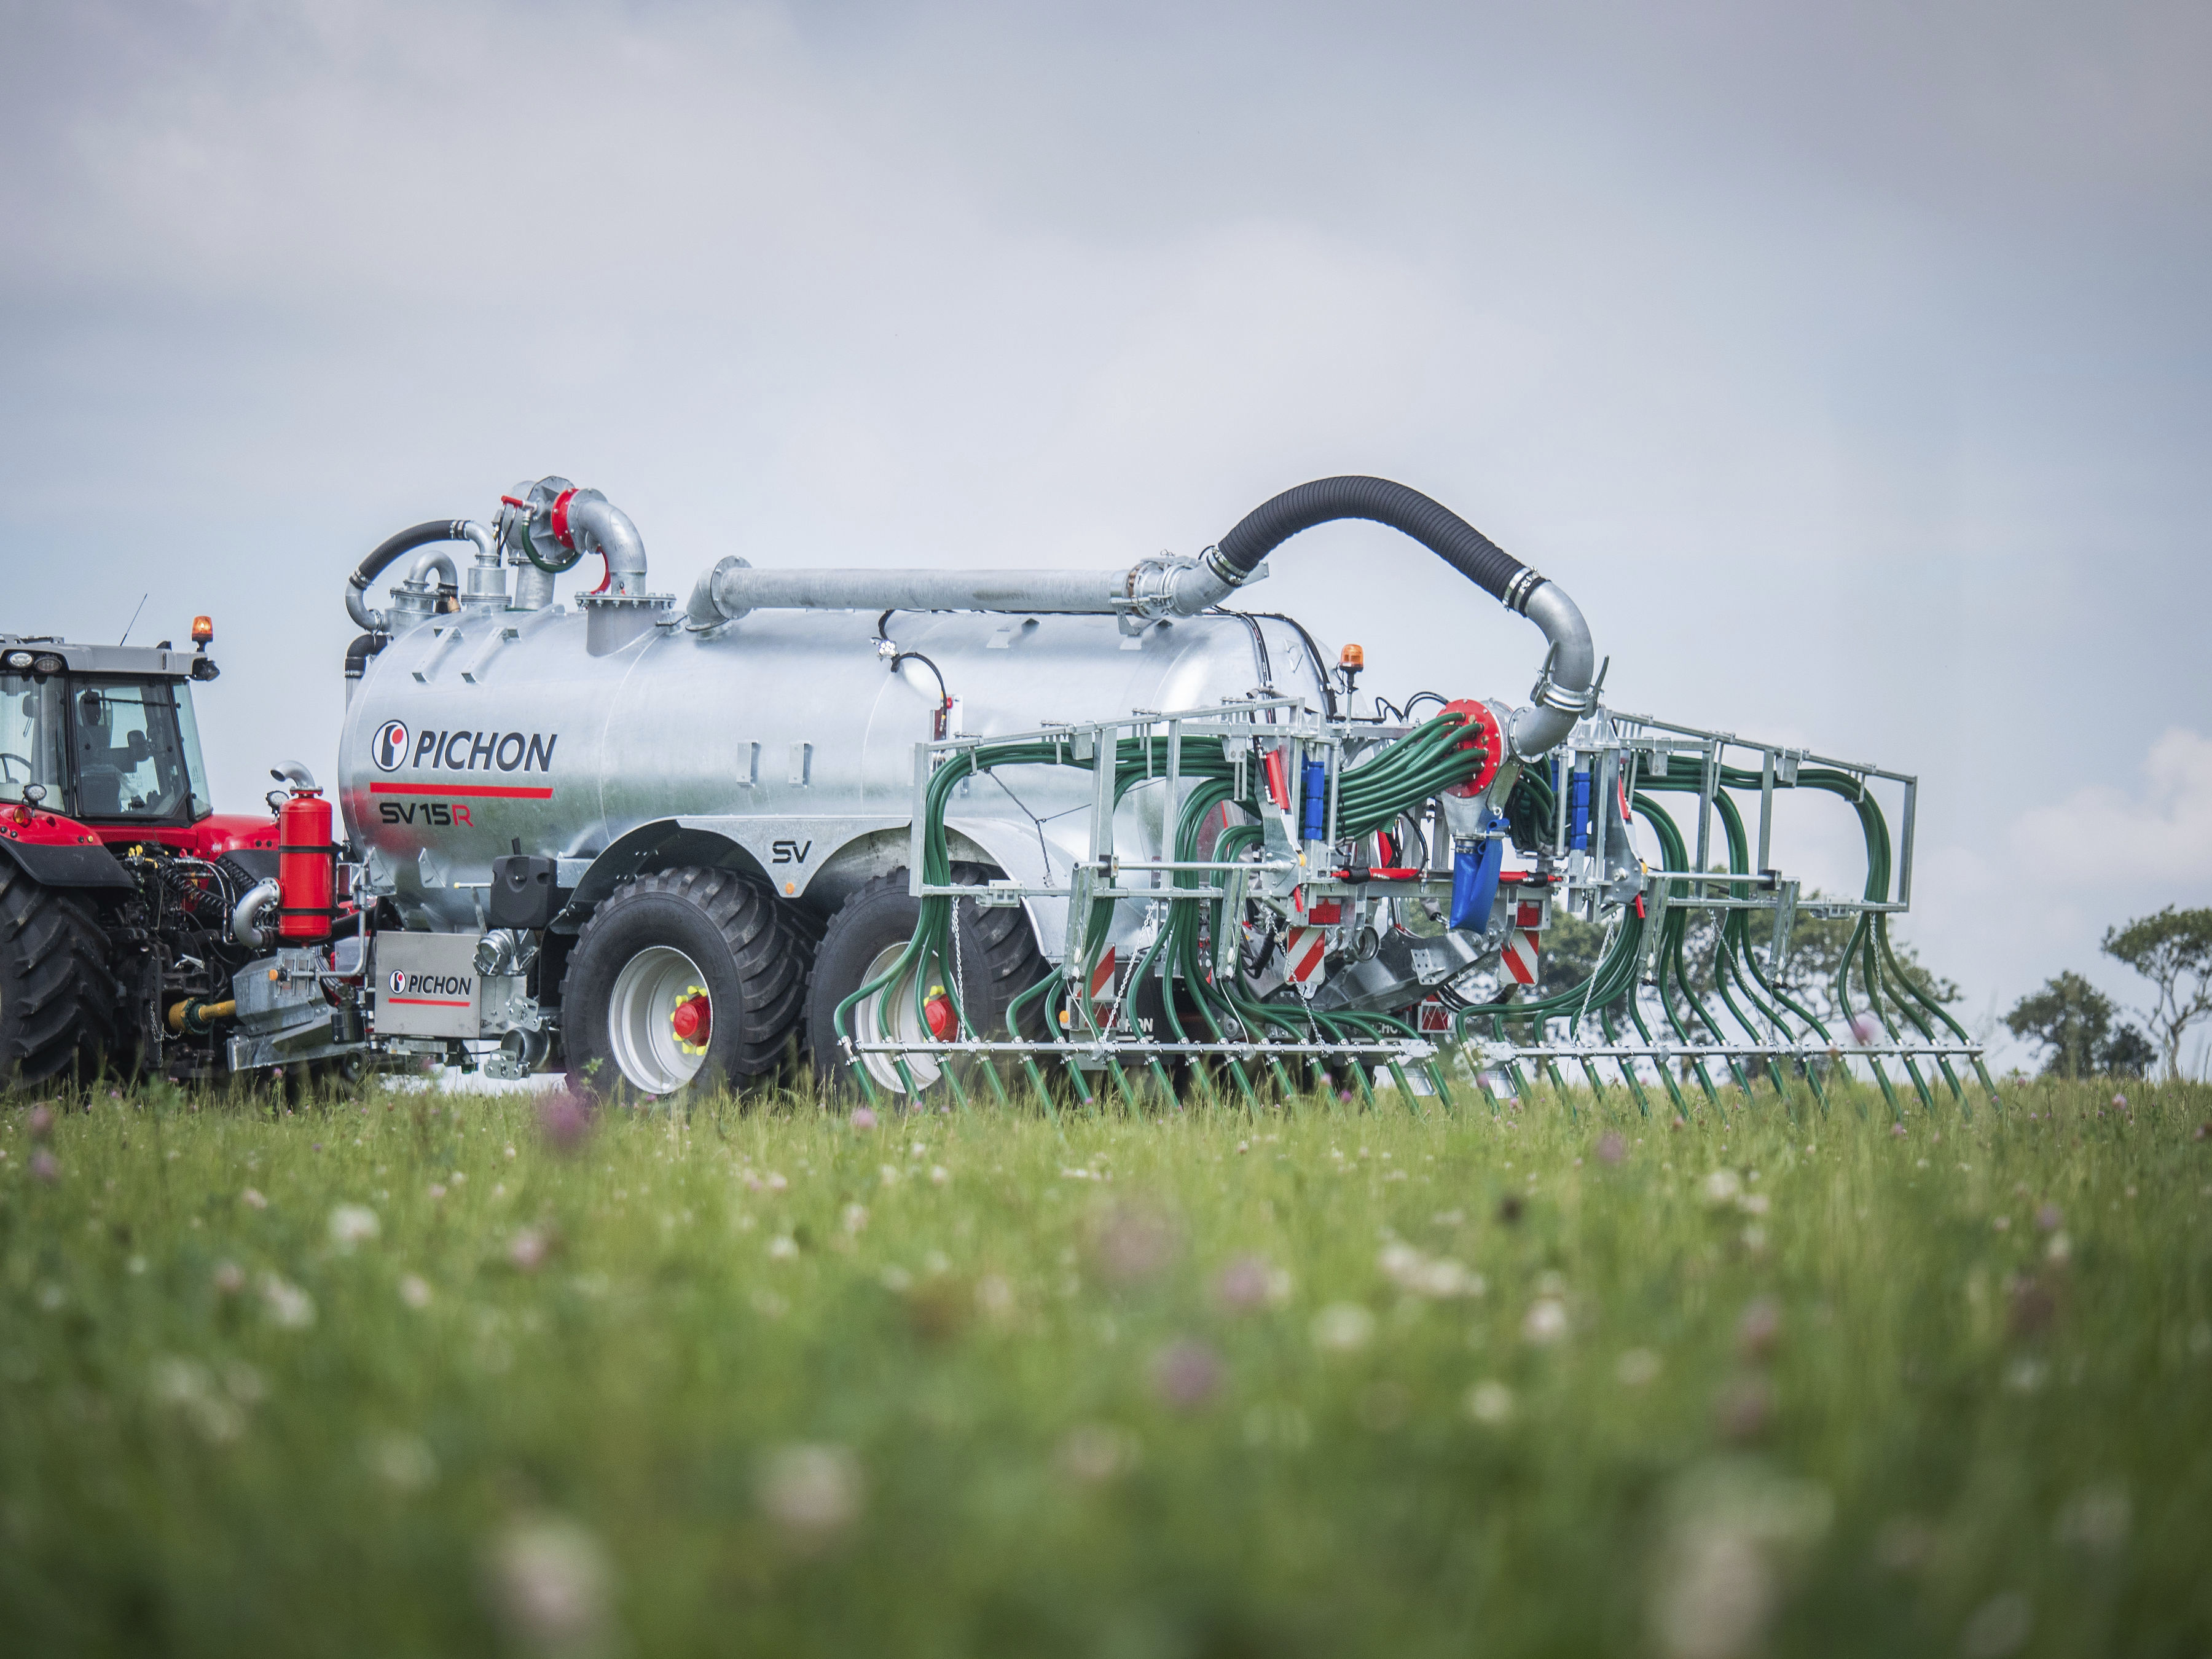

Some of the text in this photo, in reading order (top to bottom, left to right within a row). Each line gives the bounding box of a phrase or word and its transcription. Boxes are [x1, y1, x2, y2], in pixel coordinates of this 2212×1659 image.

[412, 731, 558, 772] PICHON
[772, 841, 812, 863] SV
[408, 975, 471, 995] PICHON
